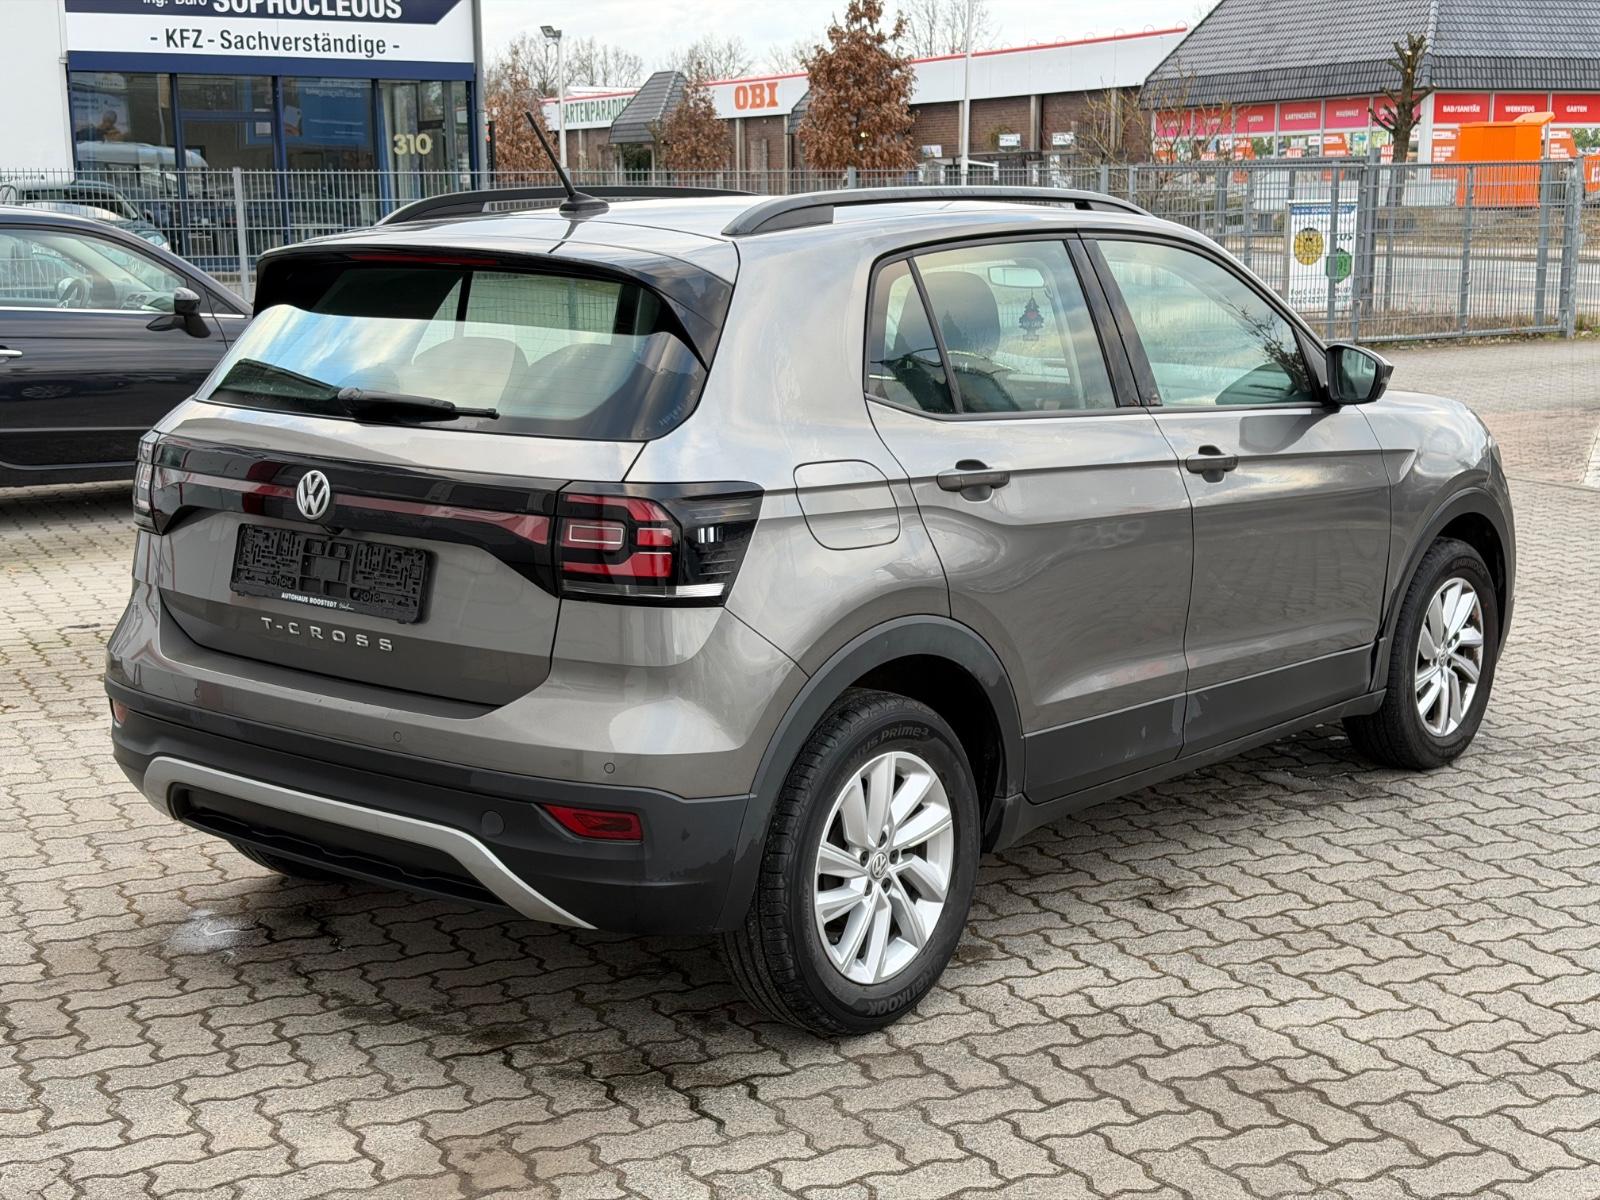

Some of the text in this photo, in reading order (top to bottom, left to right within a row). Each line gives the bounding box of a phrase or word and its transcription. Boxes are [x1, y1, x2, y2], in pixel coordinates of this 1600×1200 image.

[735, 82, 778, 110] OBI
[393, 133, 432, 155] 310
[281, 592, 308, 603] AUTOHAUS
[309, 596, 337, 608] BOOSTEDT
[260, 616, 393, 652] T-CROSS
